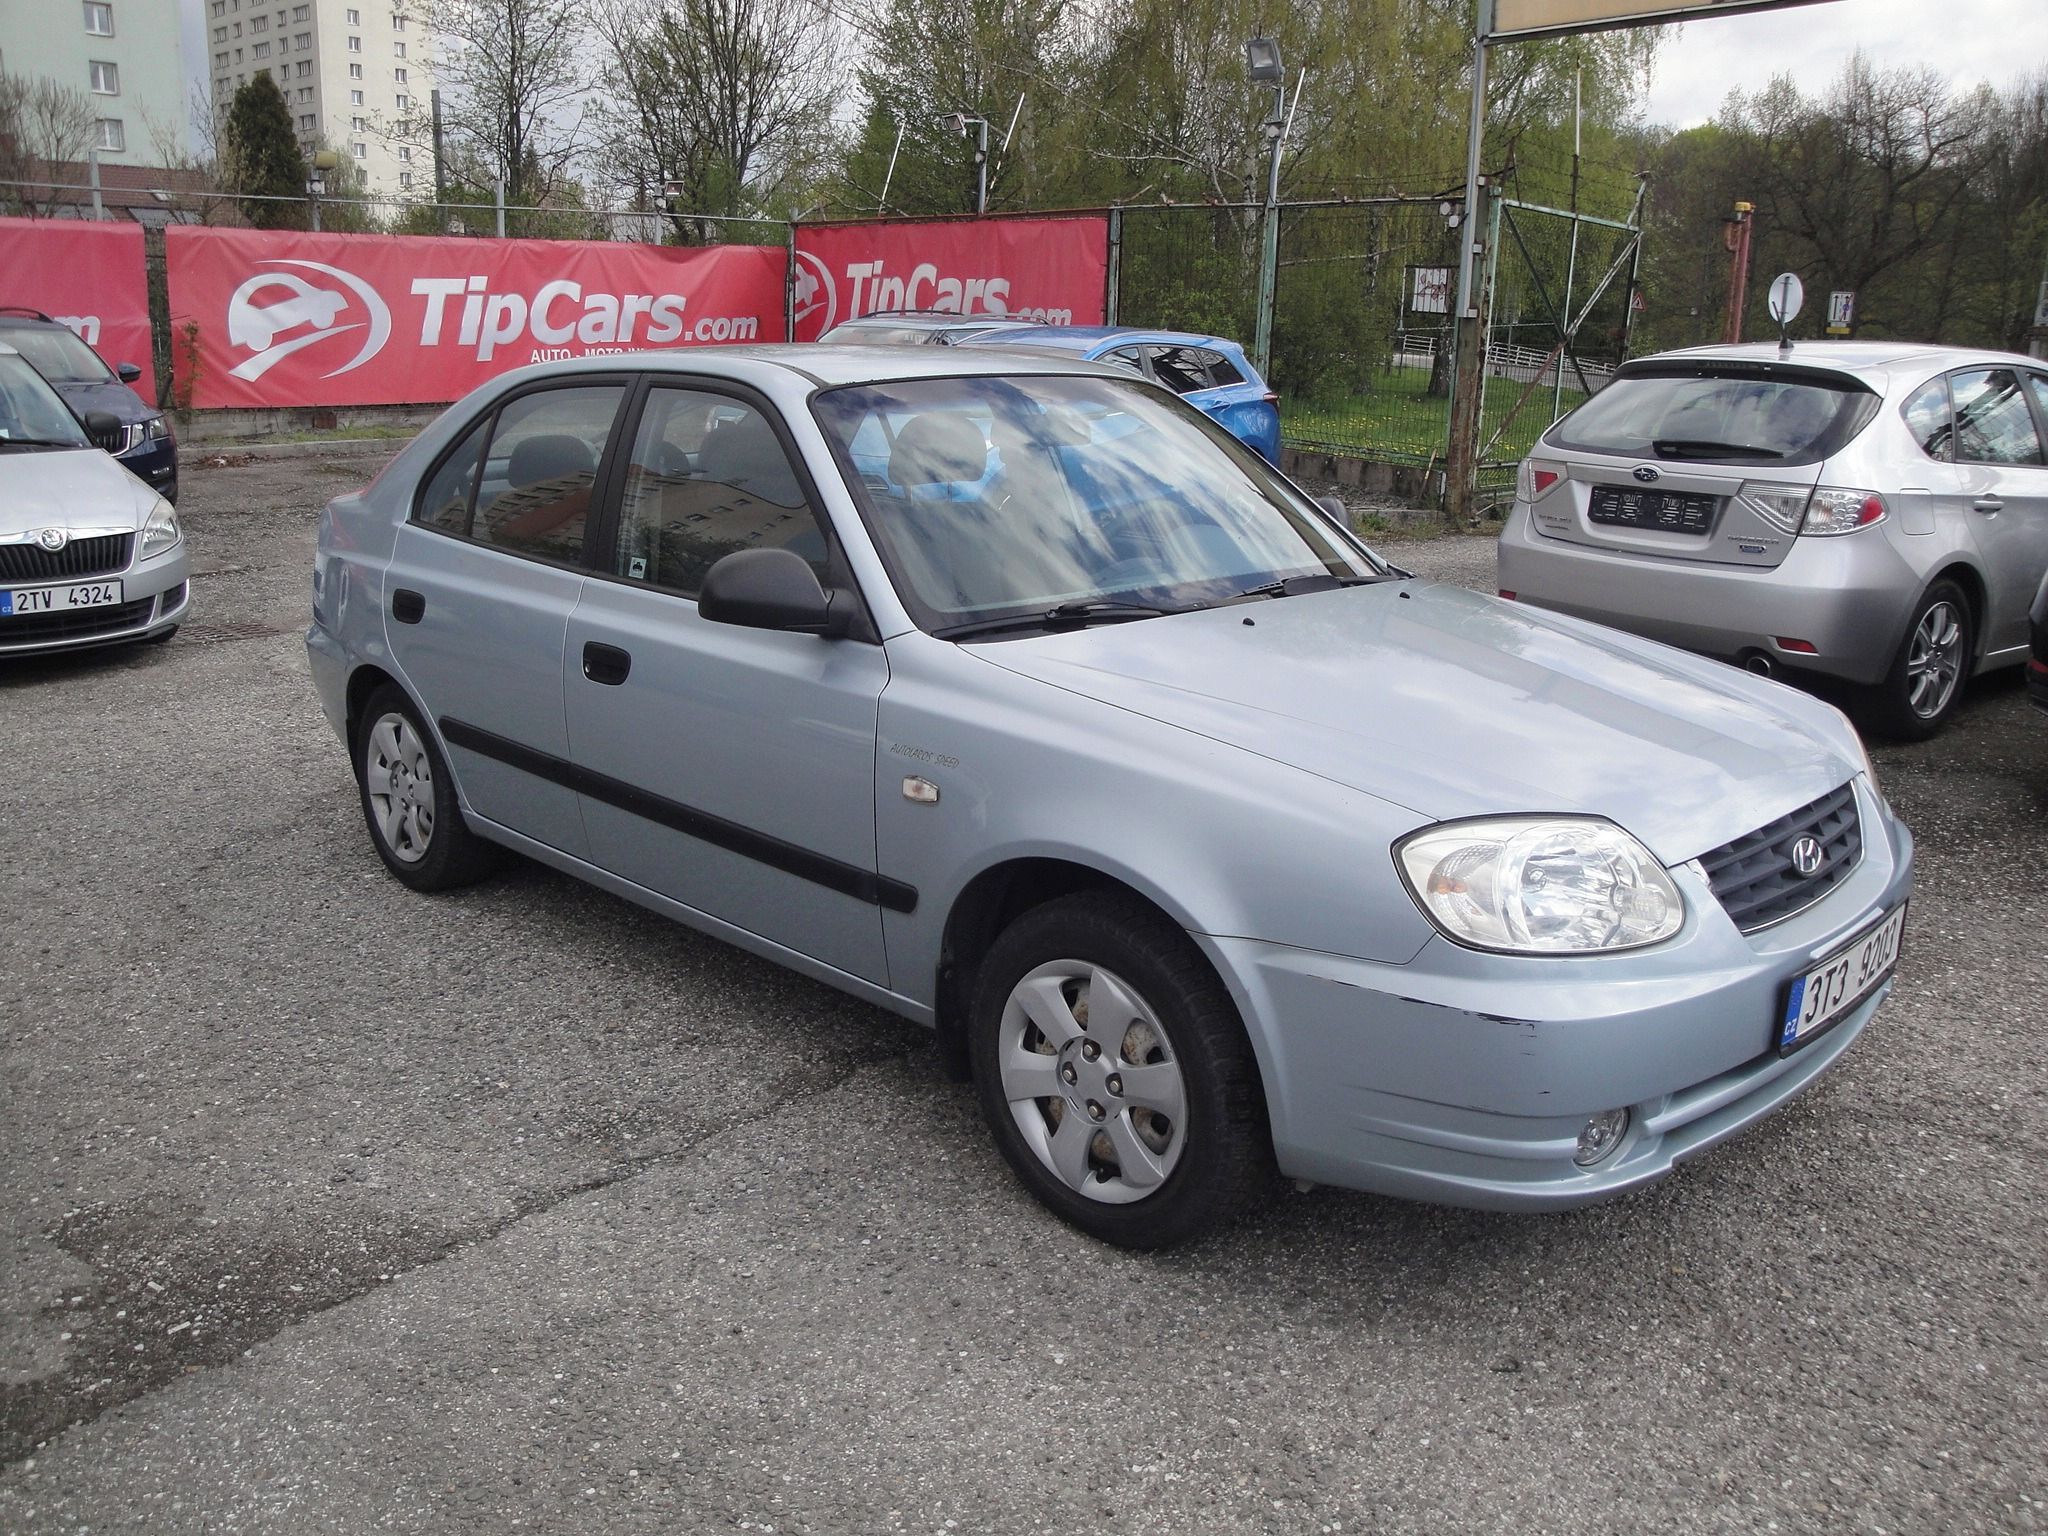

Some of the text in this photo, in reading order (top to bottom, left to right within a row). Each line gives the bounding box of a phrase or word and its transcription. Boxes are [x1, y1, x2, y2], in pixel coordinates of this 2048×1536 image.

[530, 349, 571, 363] AUTO
[17, 585, 113, 611] 2TV 4324
[1805, 917, 1897, 1024] 3T3 9203
[1784, 1018, 1796, 1036] CZ
